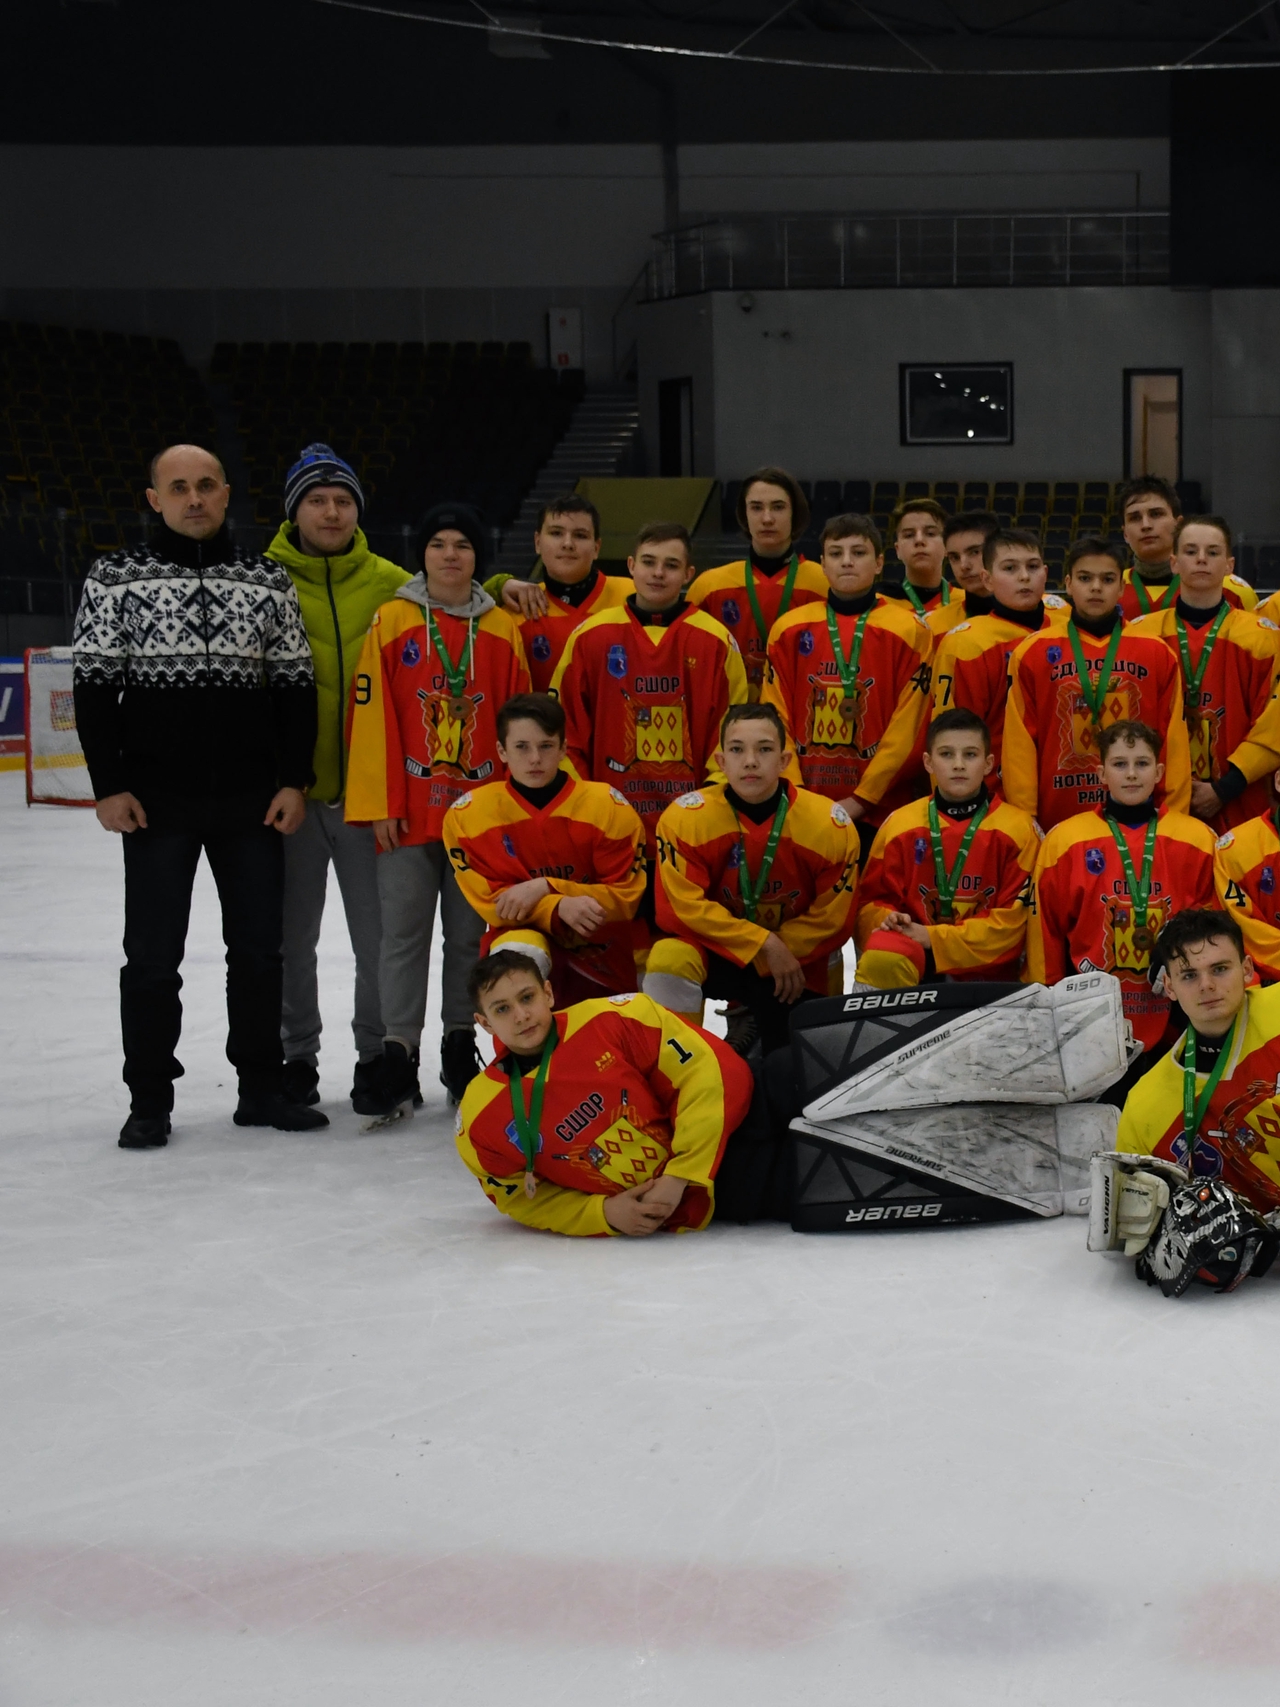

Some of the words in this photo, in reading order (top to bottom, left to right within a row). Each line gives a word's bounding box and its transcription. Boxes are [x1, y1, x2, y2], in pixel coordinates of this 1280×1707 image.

[634, 676, 680, 693] СШОР
[624, 780, 696, 795] БОГОРОДСКИ
[1053, 772, 1104, 789] НОГИ
[1077, 788, 1109, 805] РАЙ
[1224, 879, 1247, 907] 4
[843, 990, 938, 1012] BAUER
[668, 1038, 692, 1064] 1
[555, 1093, 604, 1142] СШОР
[845, 1203, 943, 1223] BAUER
